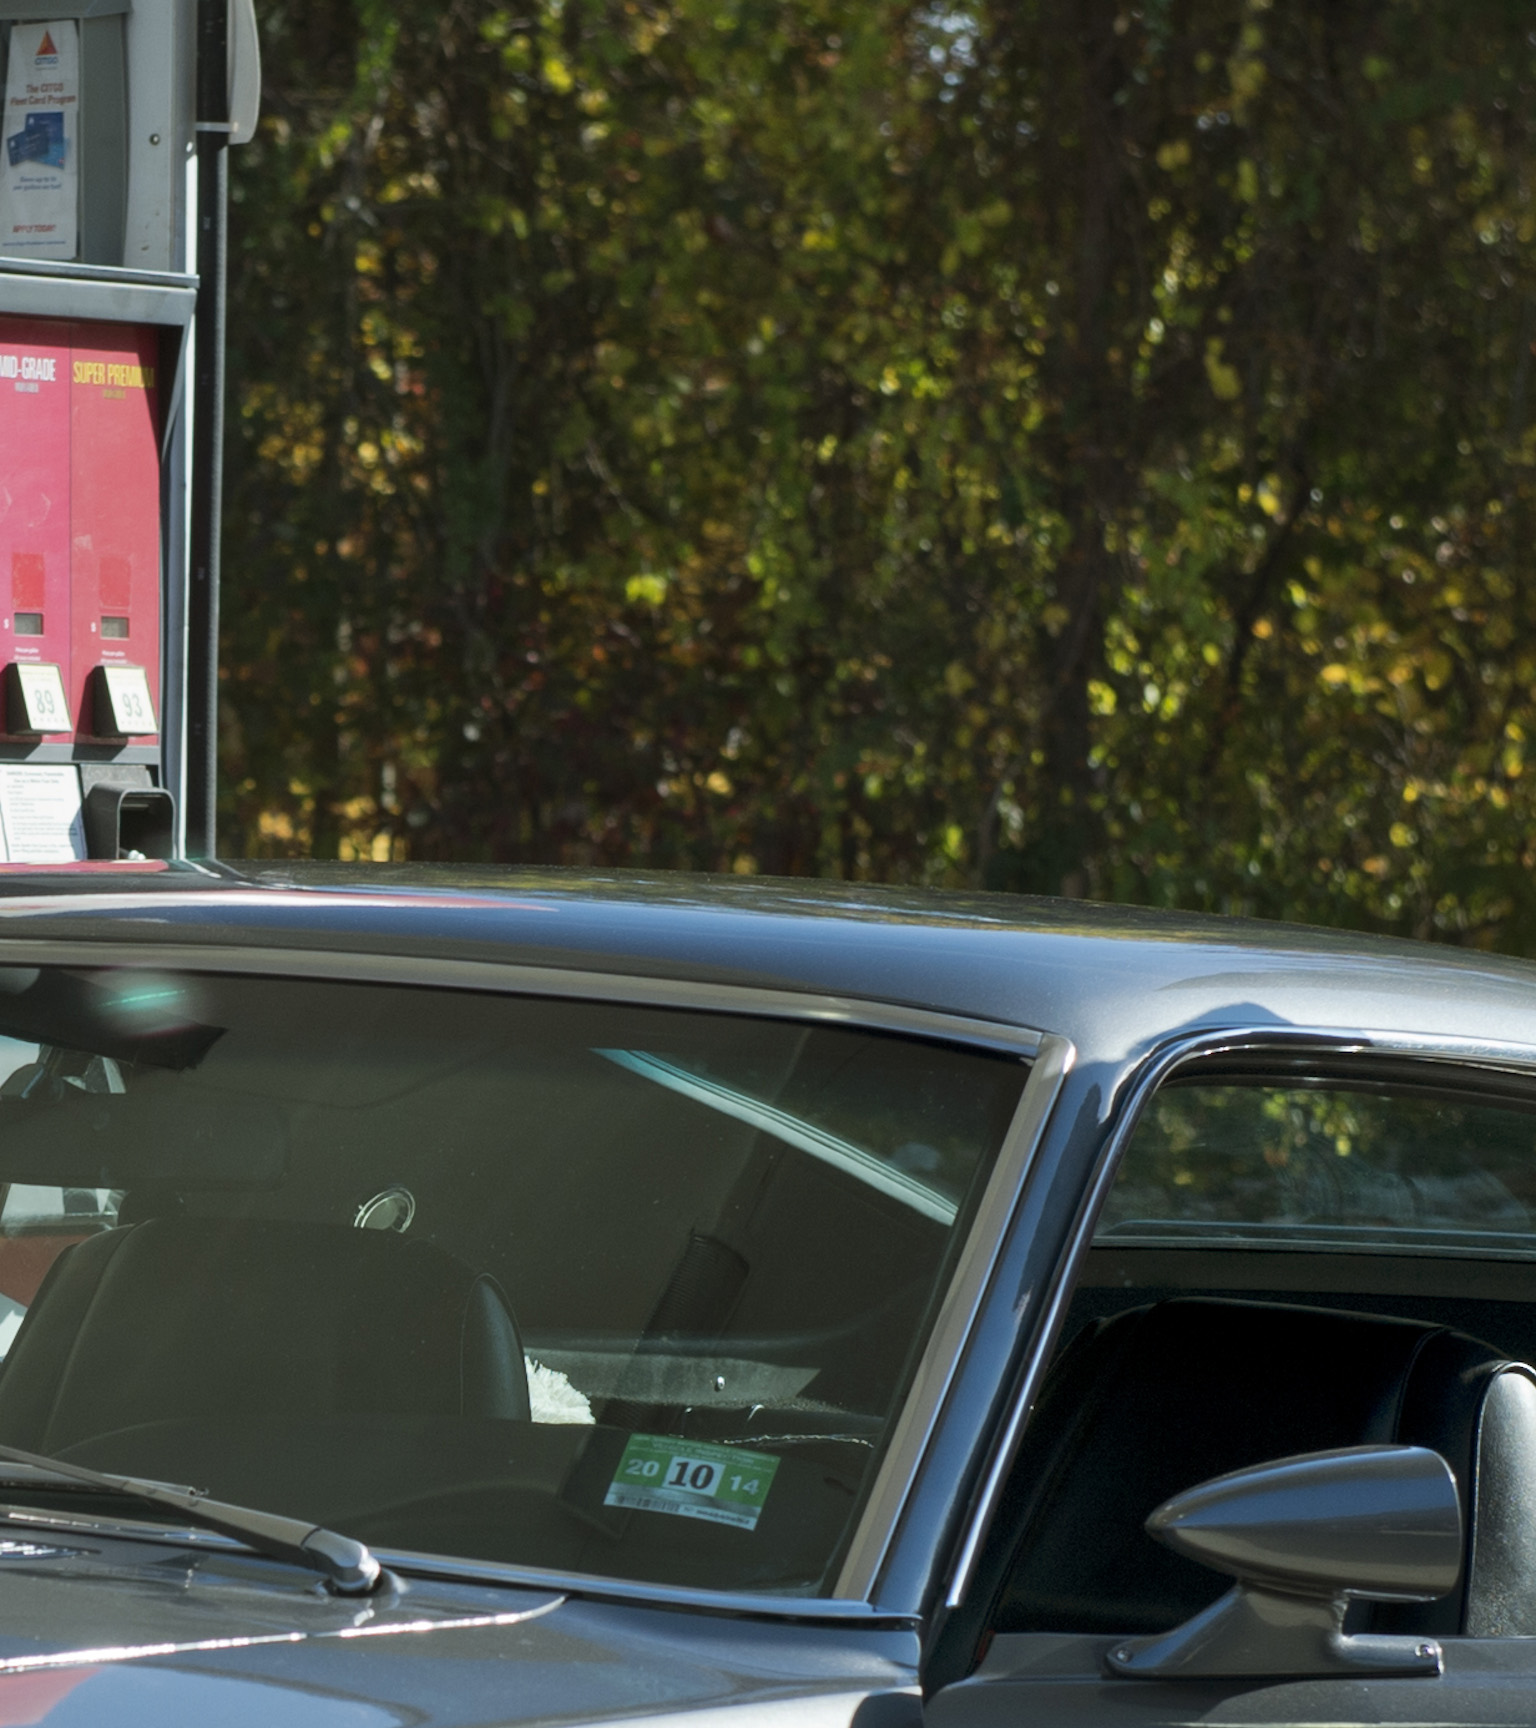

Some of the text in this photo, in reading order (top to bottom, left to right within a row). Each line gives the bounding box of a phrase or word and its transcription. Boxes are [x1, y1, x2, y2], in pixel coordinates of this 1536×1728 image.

[73, 361, 155, 389] SUPER PREMIUM
[34, 689, 55, 715] 89
[122, 693, 143, 718] 93
[625, 1458, 759, 1495] 20 10 14
